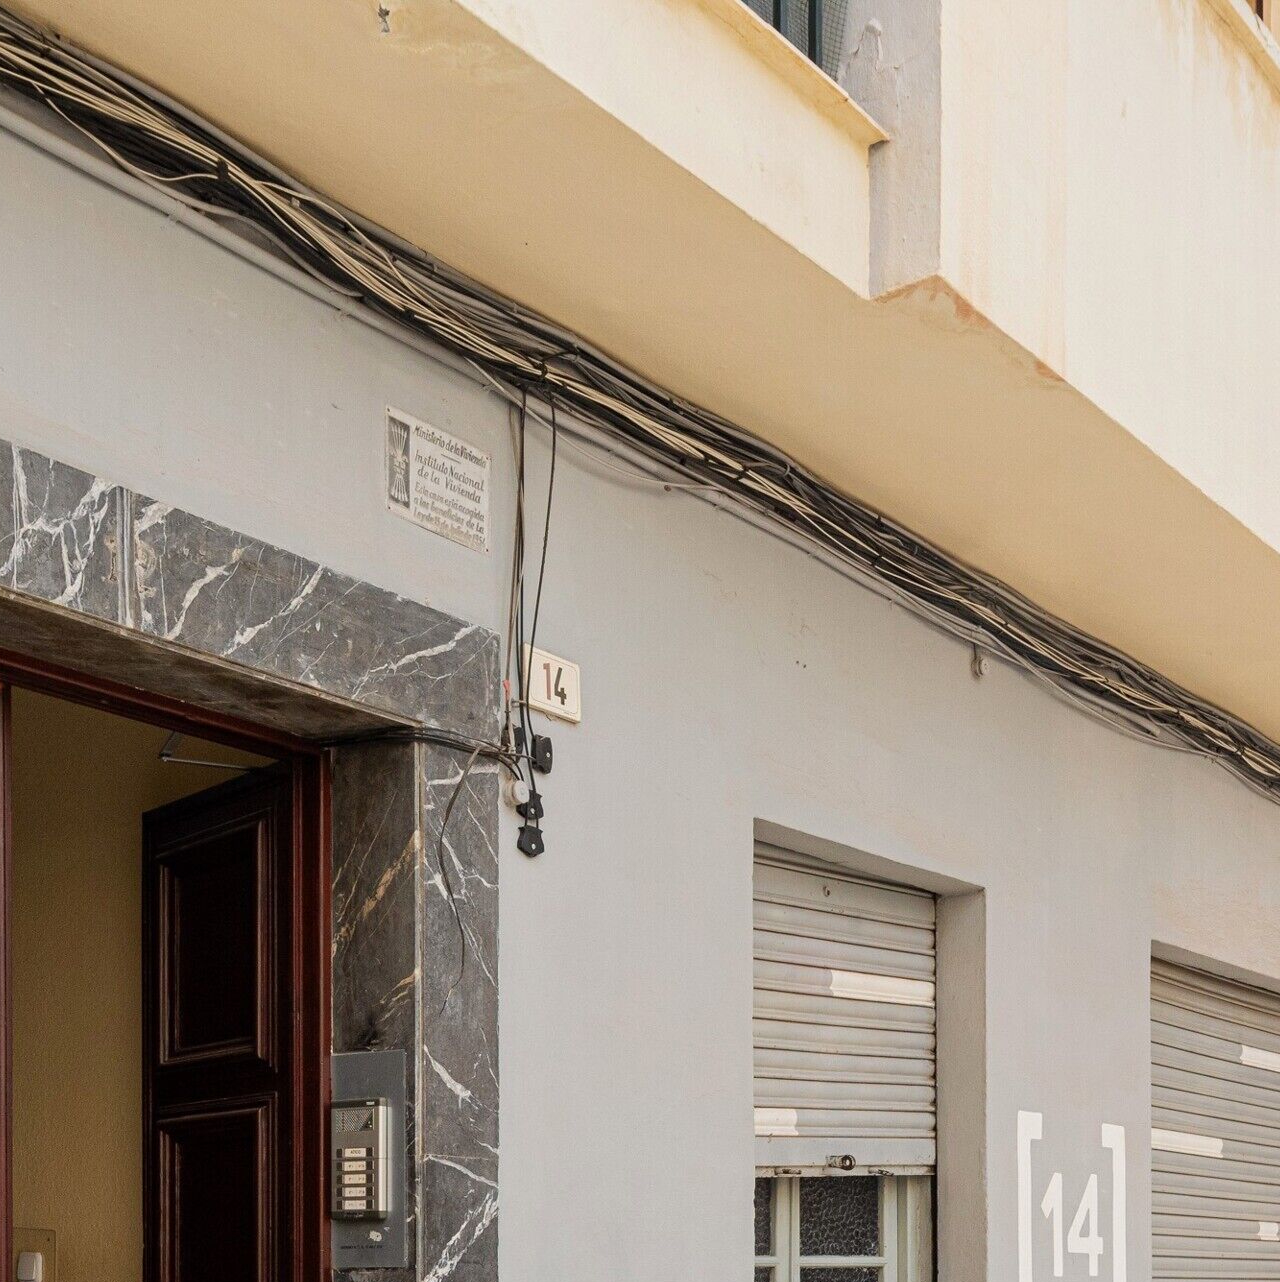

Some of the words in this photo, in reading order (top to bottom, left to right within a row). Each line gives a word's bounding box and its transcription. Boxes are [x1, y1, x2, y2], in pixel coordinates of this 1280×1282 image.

[415, 450, 448, 475] Instituto
[449, 465, 484, 491] Nacional
[418, 466, 429, 479] de
[430, 470, 440, 485] la
[446, 477, 481, 504] Vivienda
[543, 662, 567, 706] 14
